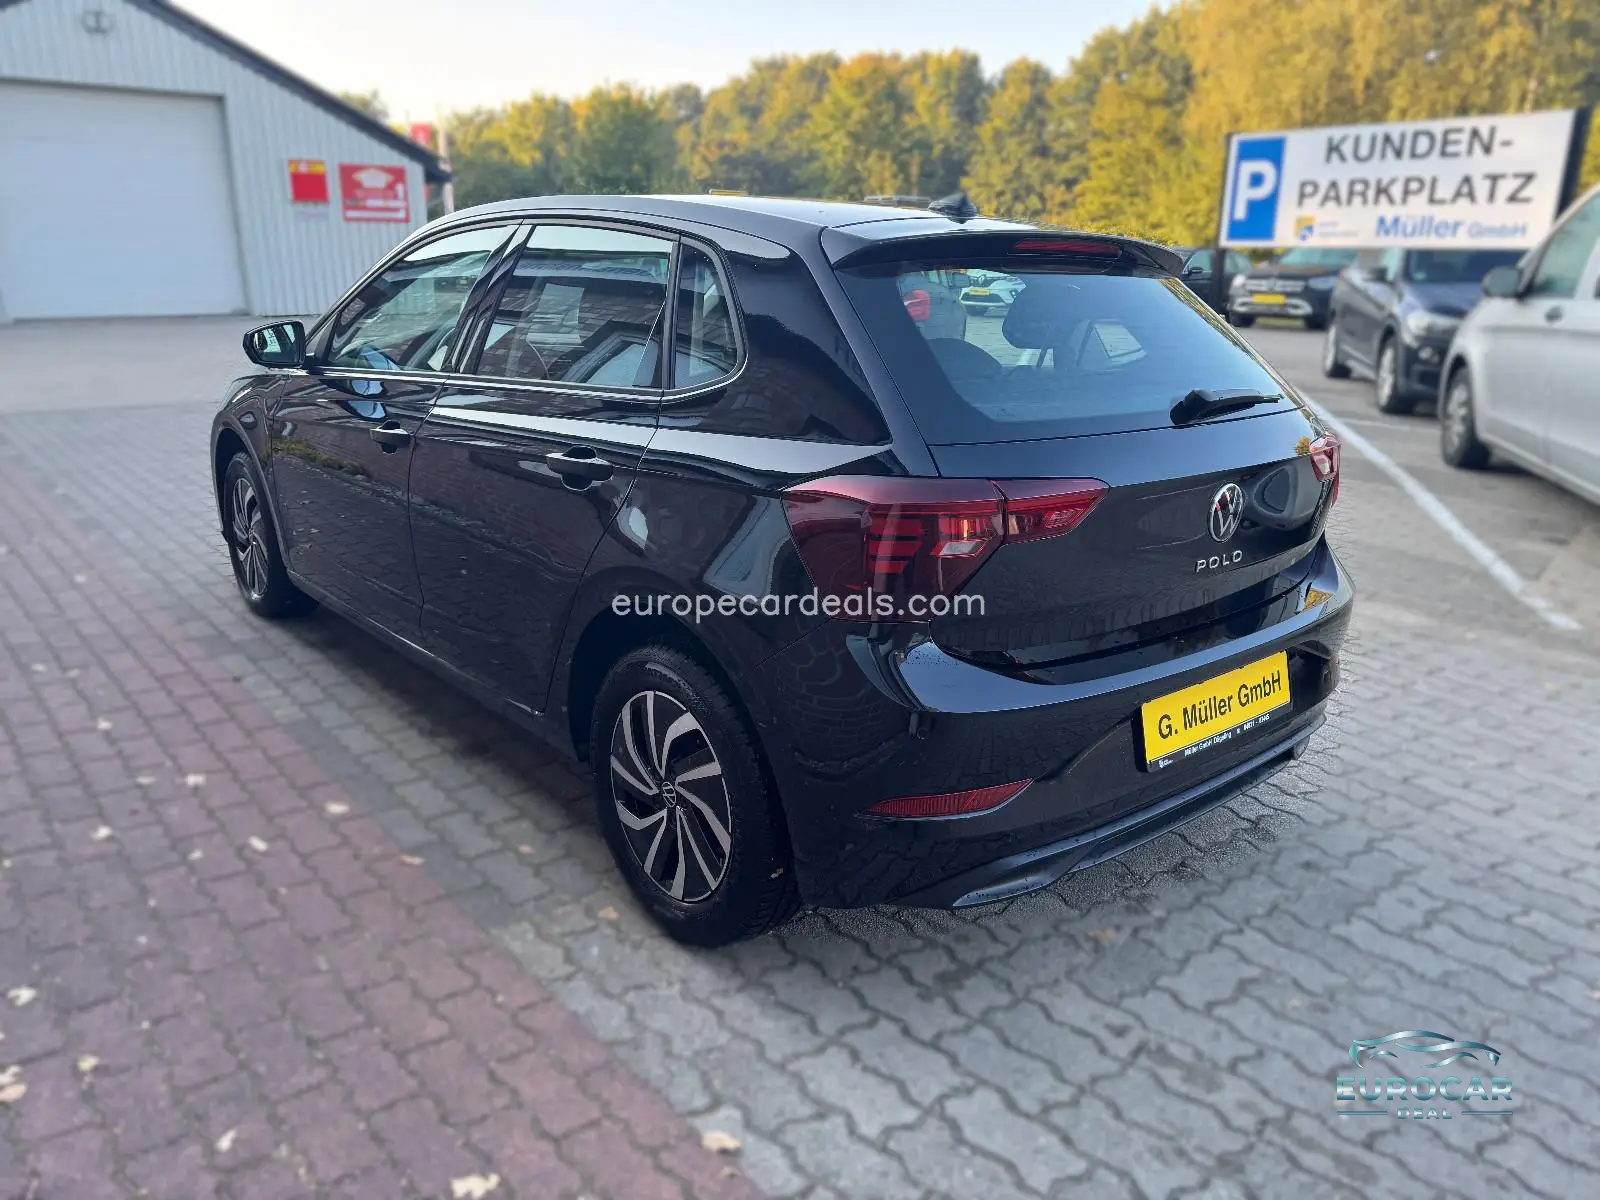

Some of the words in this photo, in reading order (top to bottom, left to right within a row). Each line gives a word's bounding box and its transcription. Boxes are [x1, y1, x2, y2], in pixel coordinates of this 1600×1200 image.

[1324, 125, 1514, 164] KUNDEN-
[1233, 160, 1277, 221] P
[1297, 172, 1537, 207] PARKPLATZ
[1375, 214, 1464, 239] Müller
[1467, 221, 1528, 239] GmbH
[1195, 550, 1243, 573] POLO
[1158, 713, 1179, 740] G.
[1182, 694, 1233, 731] Müller
[1237, 670, 1282, 708] GmbH
